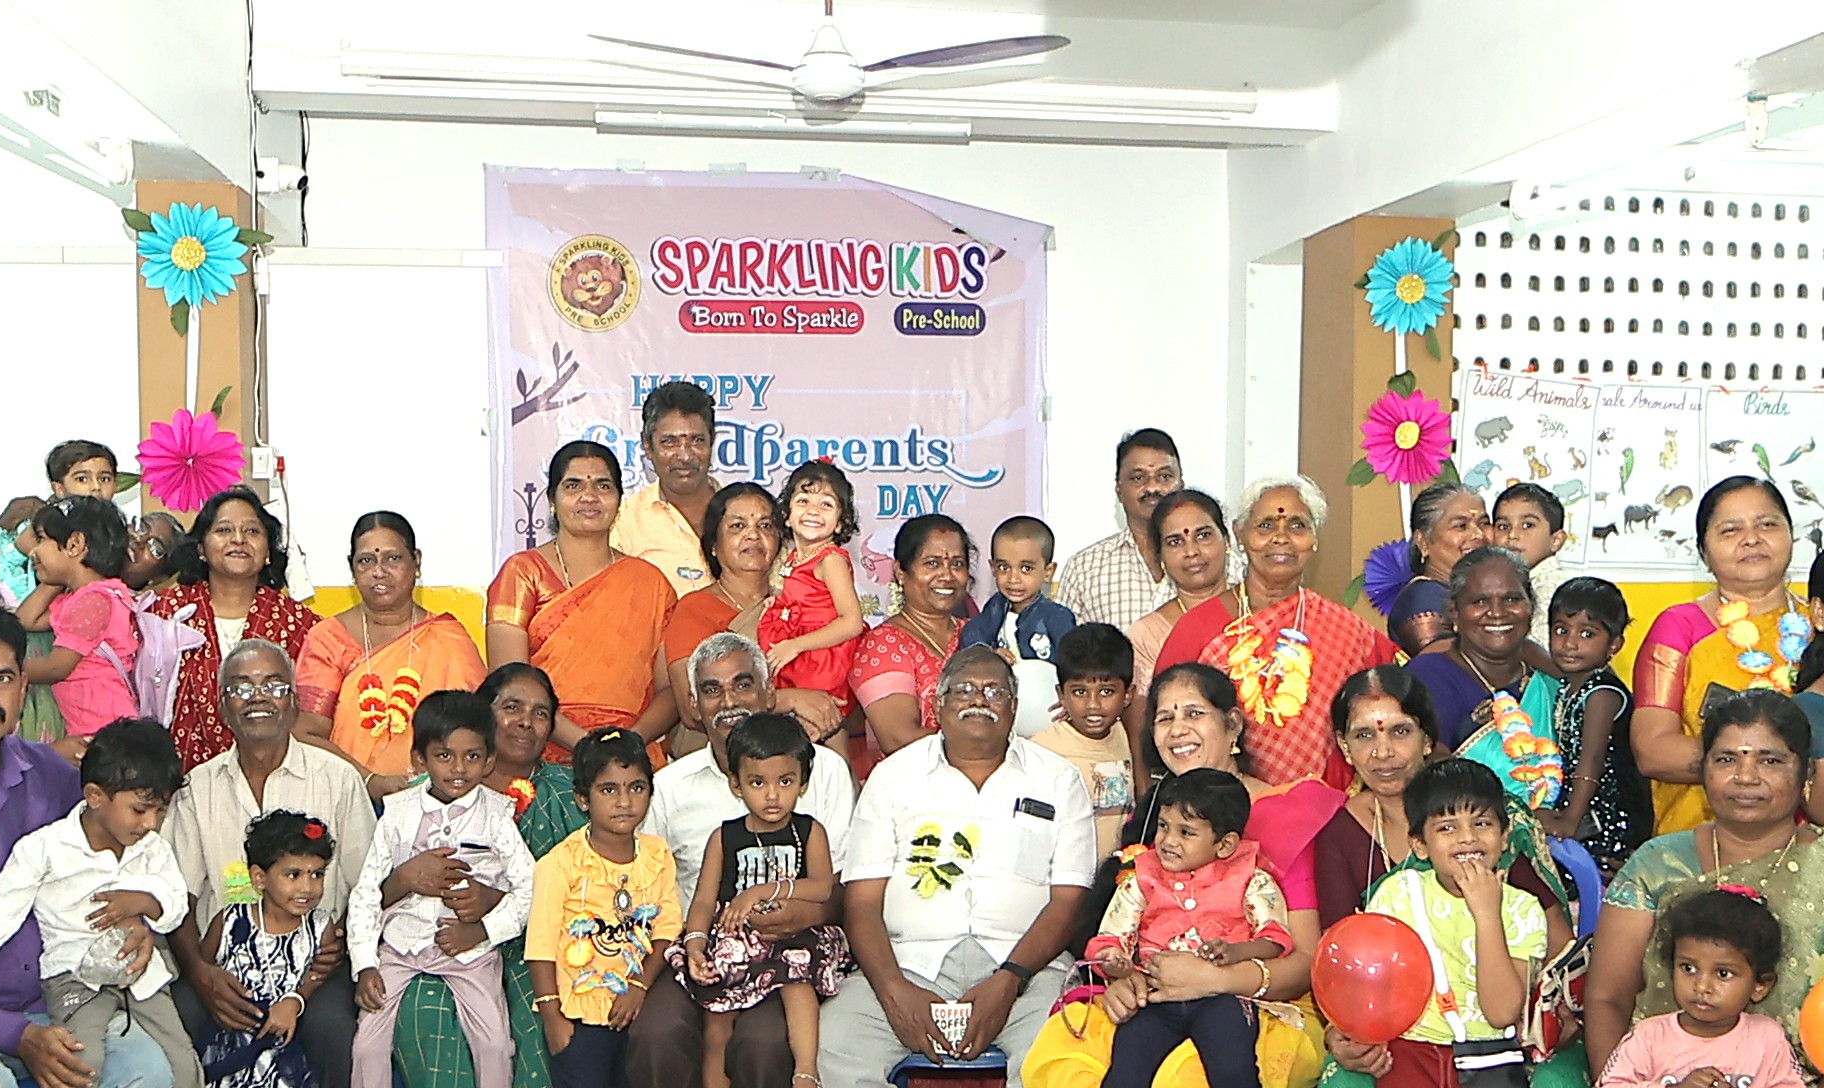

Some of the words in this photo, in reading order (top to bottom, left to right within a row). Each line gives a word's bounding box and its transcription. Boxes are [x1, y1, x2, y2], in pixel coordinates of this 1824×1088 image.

[559, 240, 609, 266] SPARKLING
[611, 246, 630, 267] KIDS
[655, 238, 886, 294] SPARKLING
[894, 244, 986, 294] KIDS
[564, 306, 584, 324] PRE
[592, 301, 631, 326] SCHOOL
[692, 305, 746, 328] Born
[750, 305, 777, 328] To
[782, 304, 860, 333] Sparkle
[902, 310, 981, 331] Pre-School
[631, 374, 774, 408] HPPY
[1472, 373, 1515, 400] Wild
[1517, 379, 1592, 410] Animals
[1628, 389, 1687, 411] Around
[1743, 390, 1791, 416] Birds
[876, 484, 950, 516] DAY
